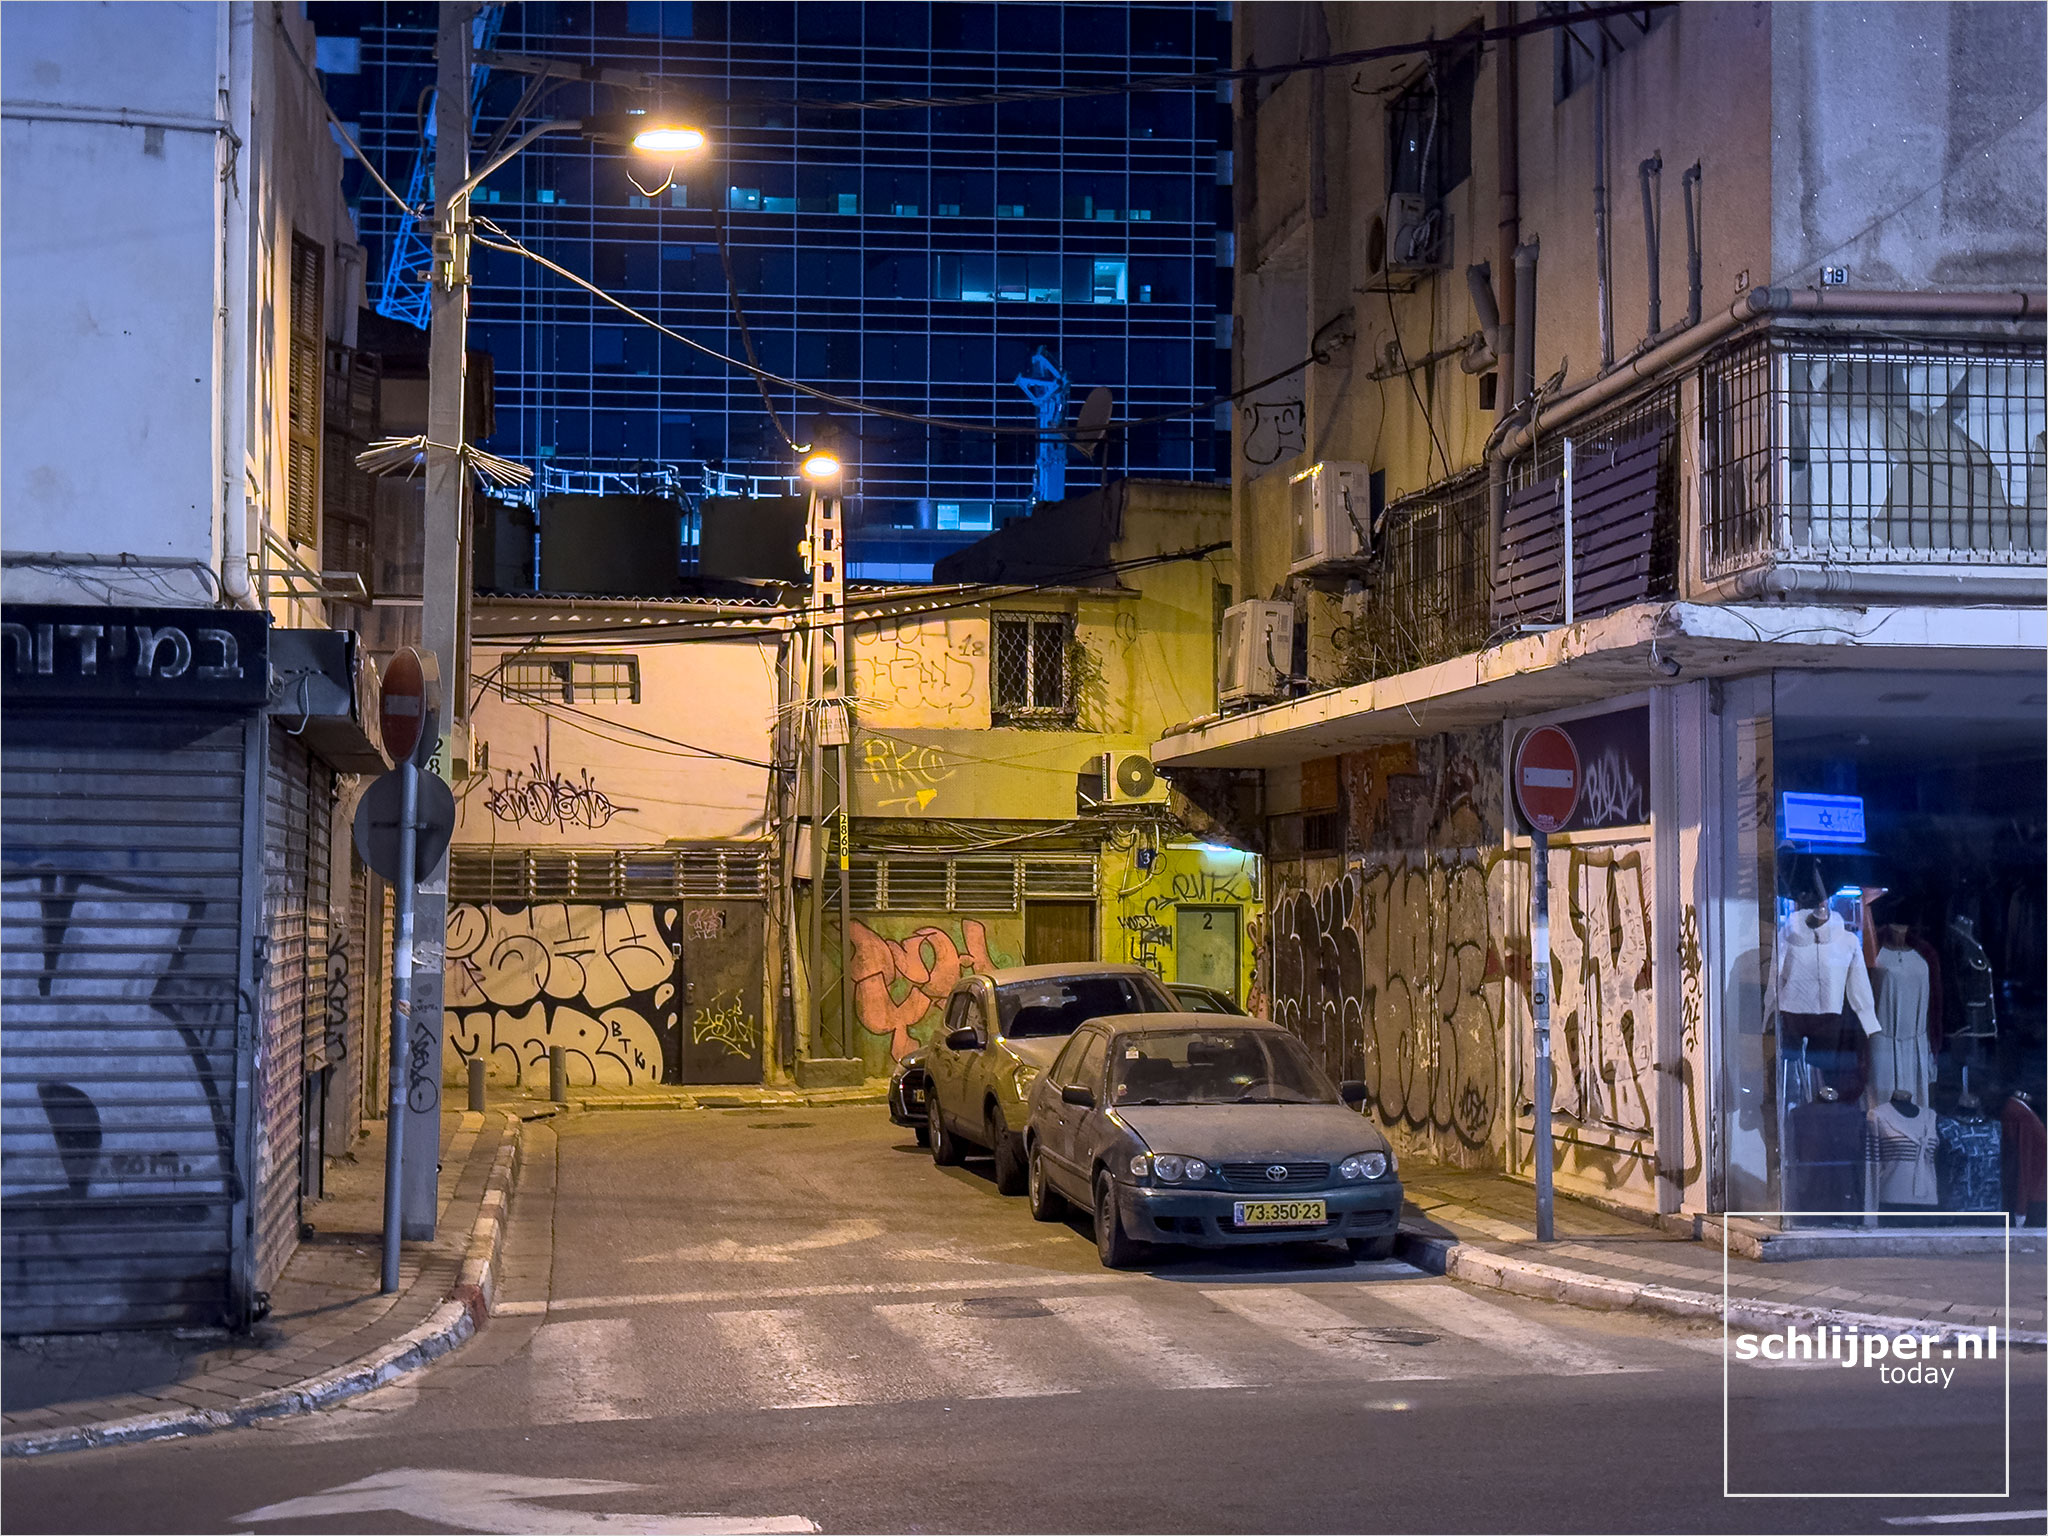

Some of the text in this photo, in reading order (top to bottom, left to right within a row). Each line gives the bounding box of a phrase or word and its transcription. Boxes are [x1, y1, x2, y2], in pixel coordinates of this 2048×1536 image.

[1829, 268, 1844, 284] 19
[1143, 849, 1151, 865] 3
[1202, 912, 1213, 930] 2
